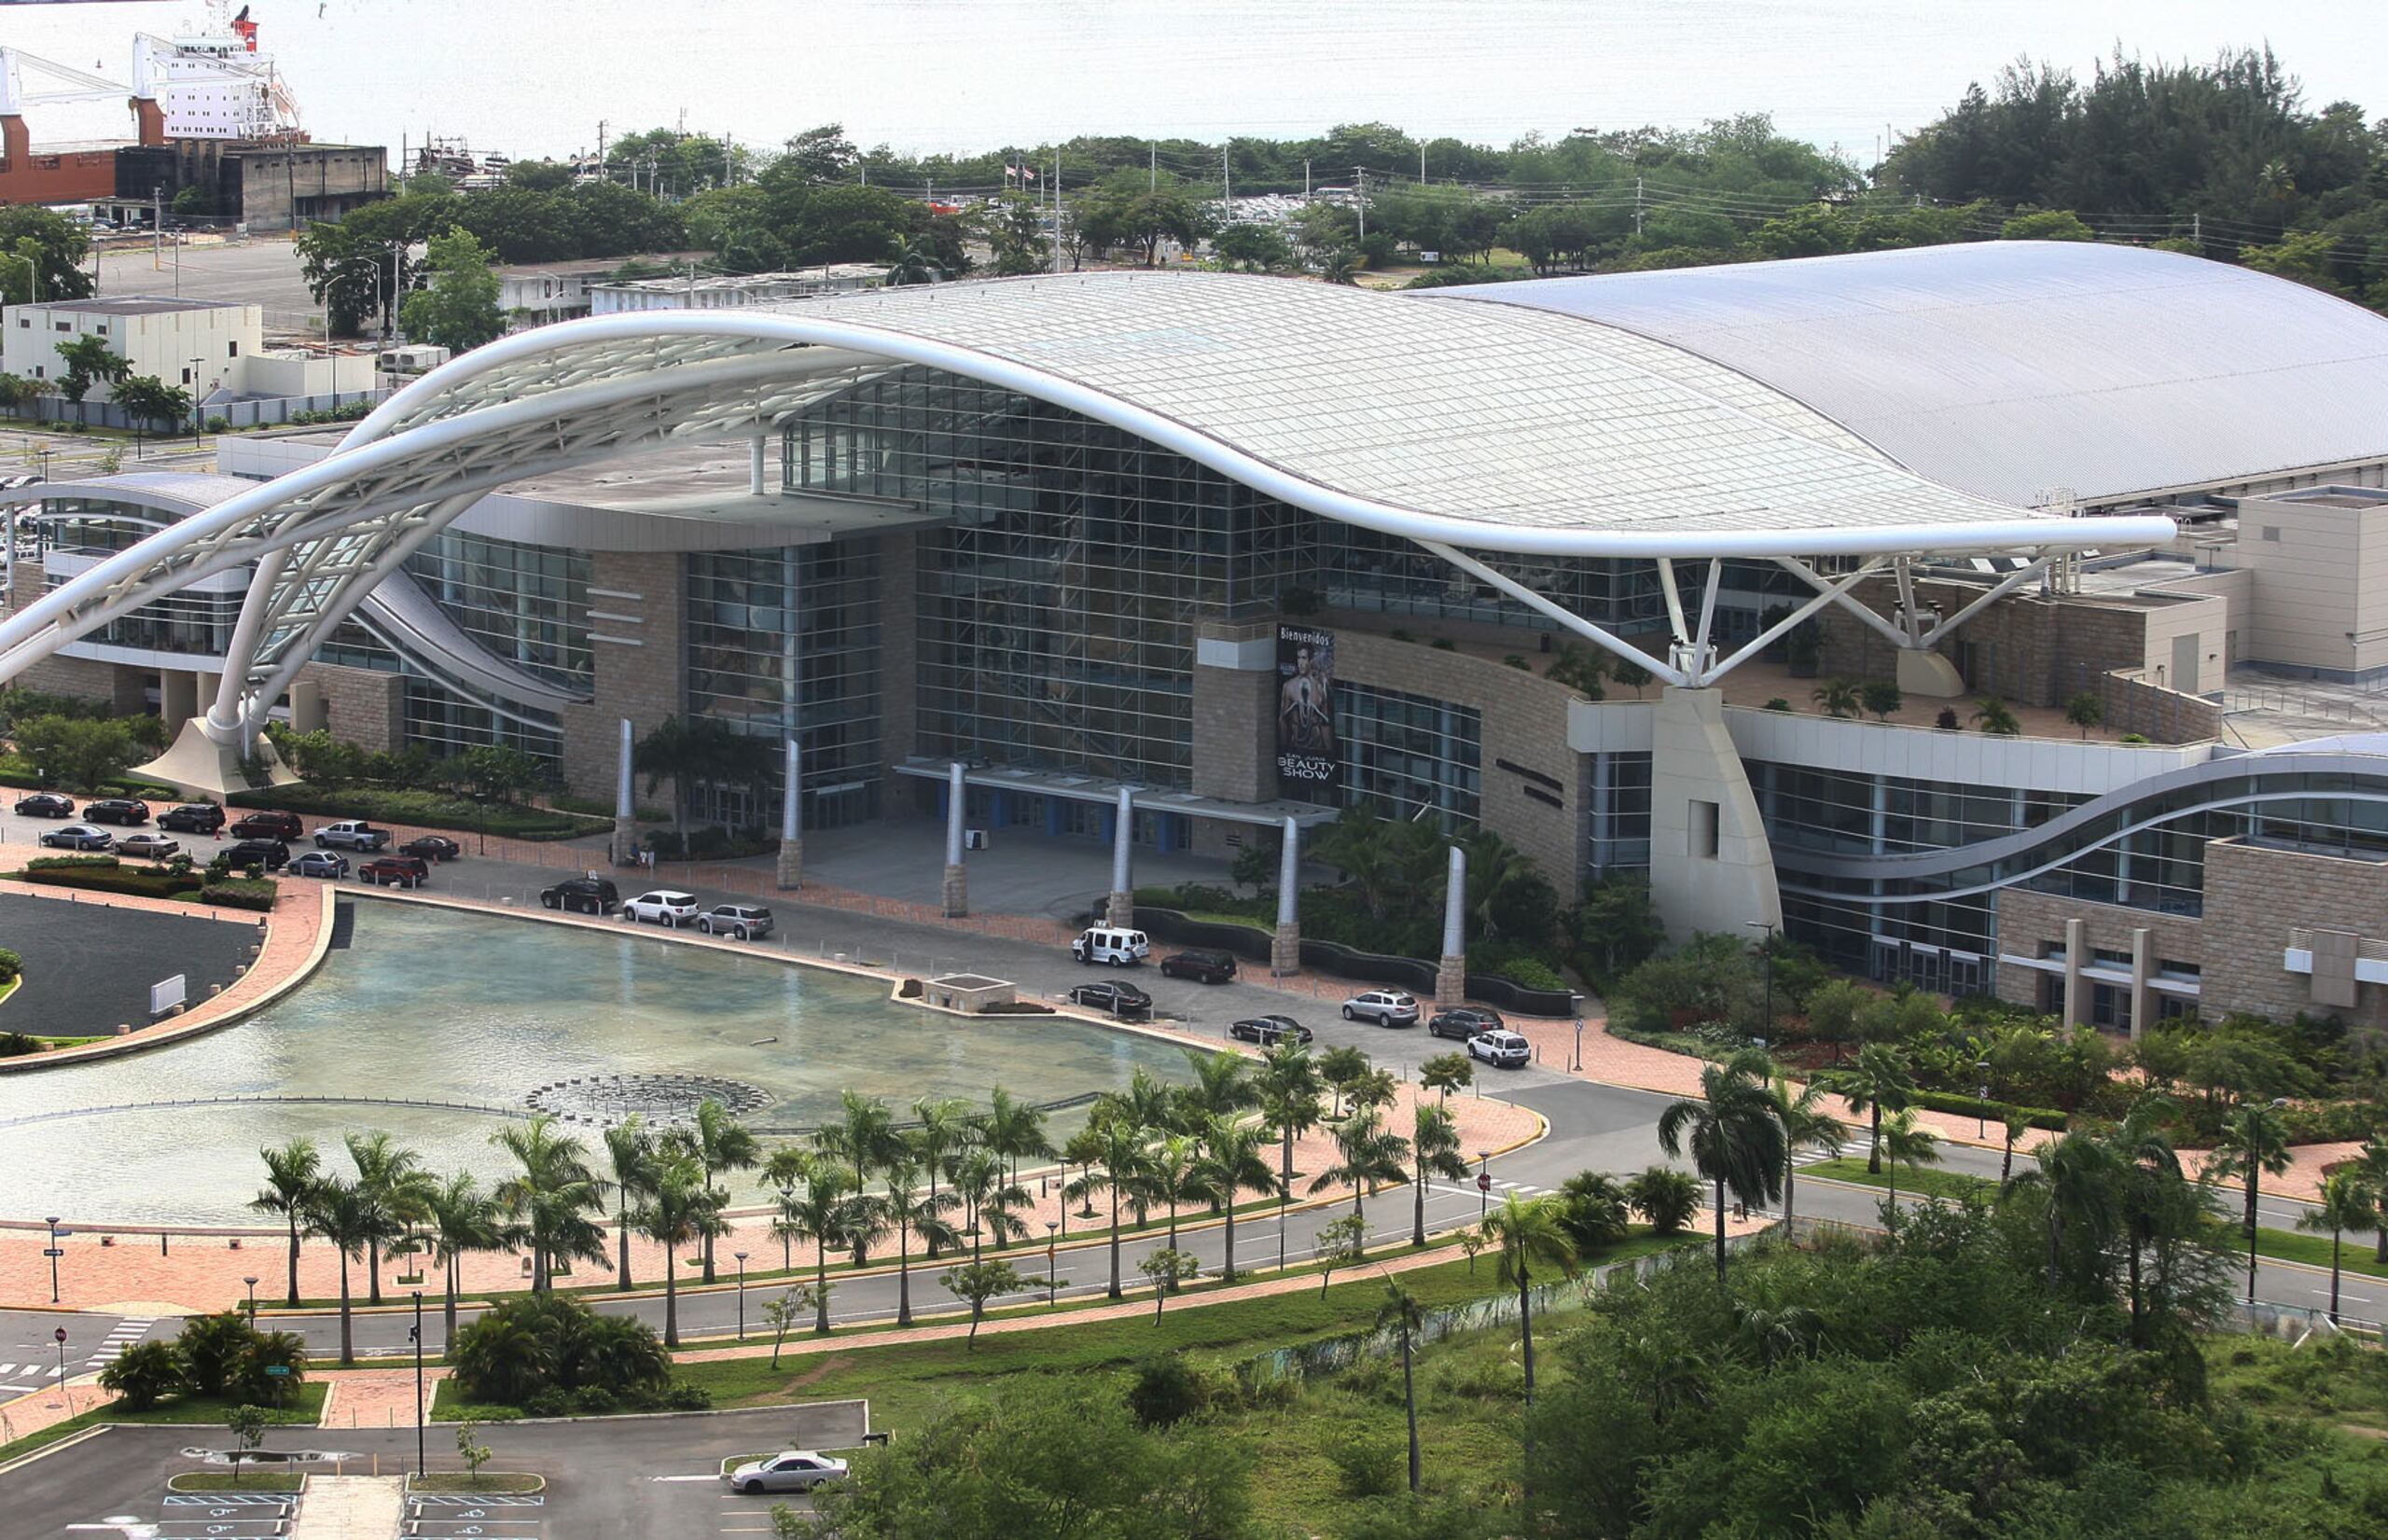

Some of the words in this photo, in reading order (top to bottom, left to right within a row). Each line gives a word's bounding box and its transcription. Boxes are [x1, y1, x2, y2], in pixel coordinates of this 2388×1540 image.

[1281, 626, 1329, 646] Bienvenidos
[1278, 756, 1336, 771] BEAUTY
[1284, 766, 1329, 780] SHOW
